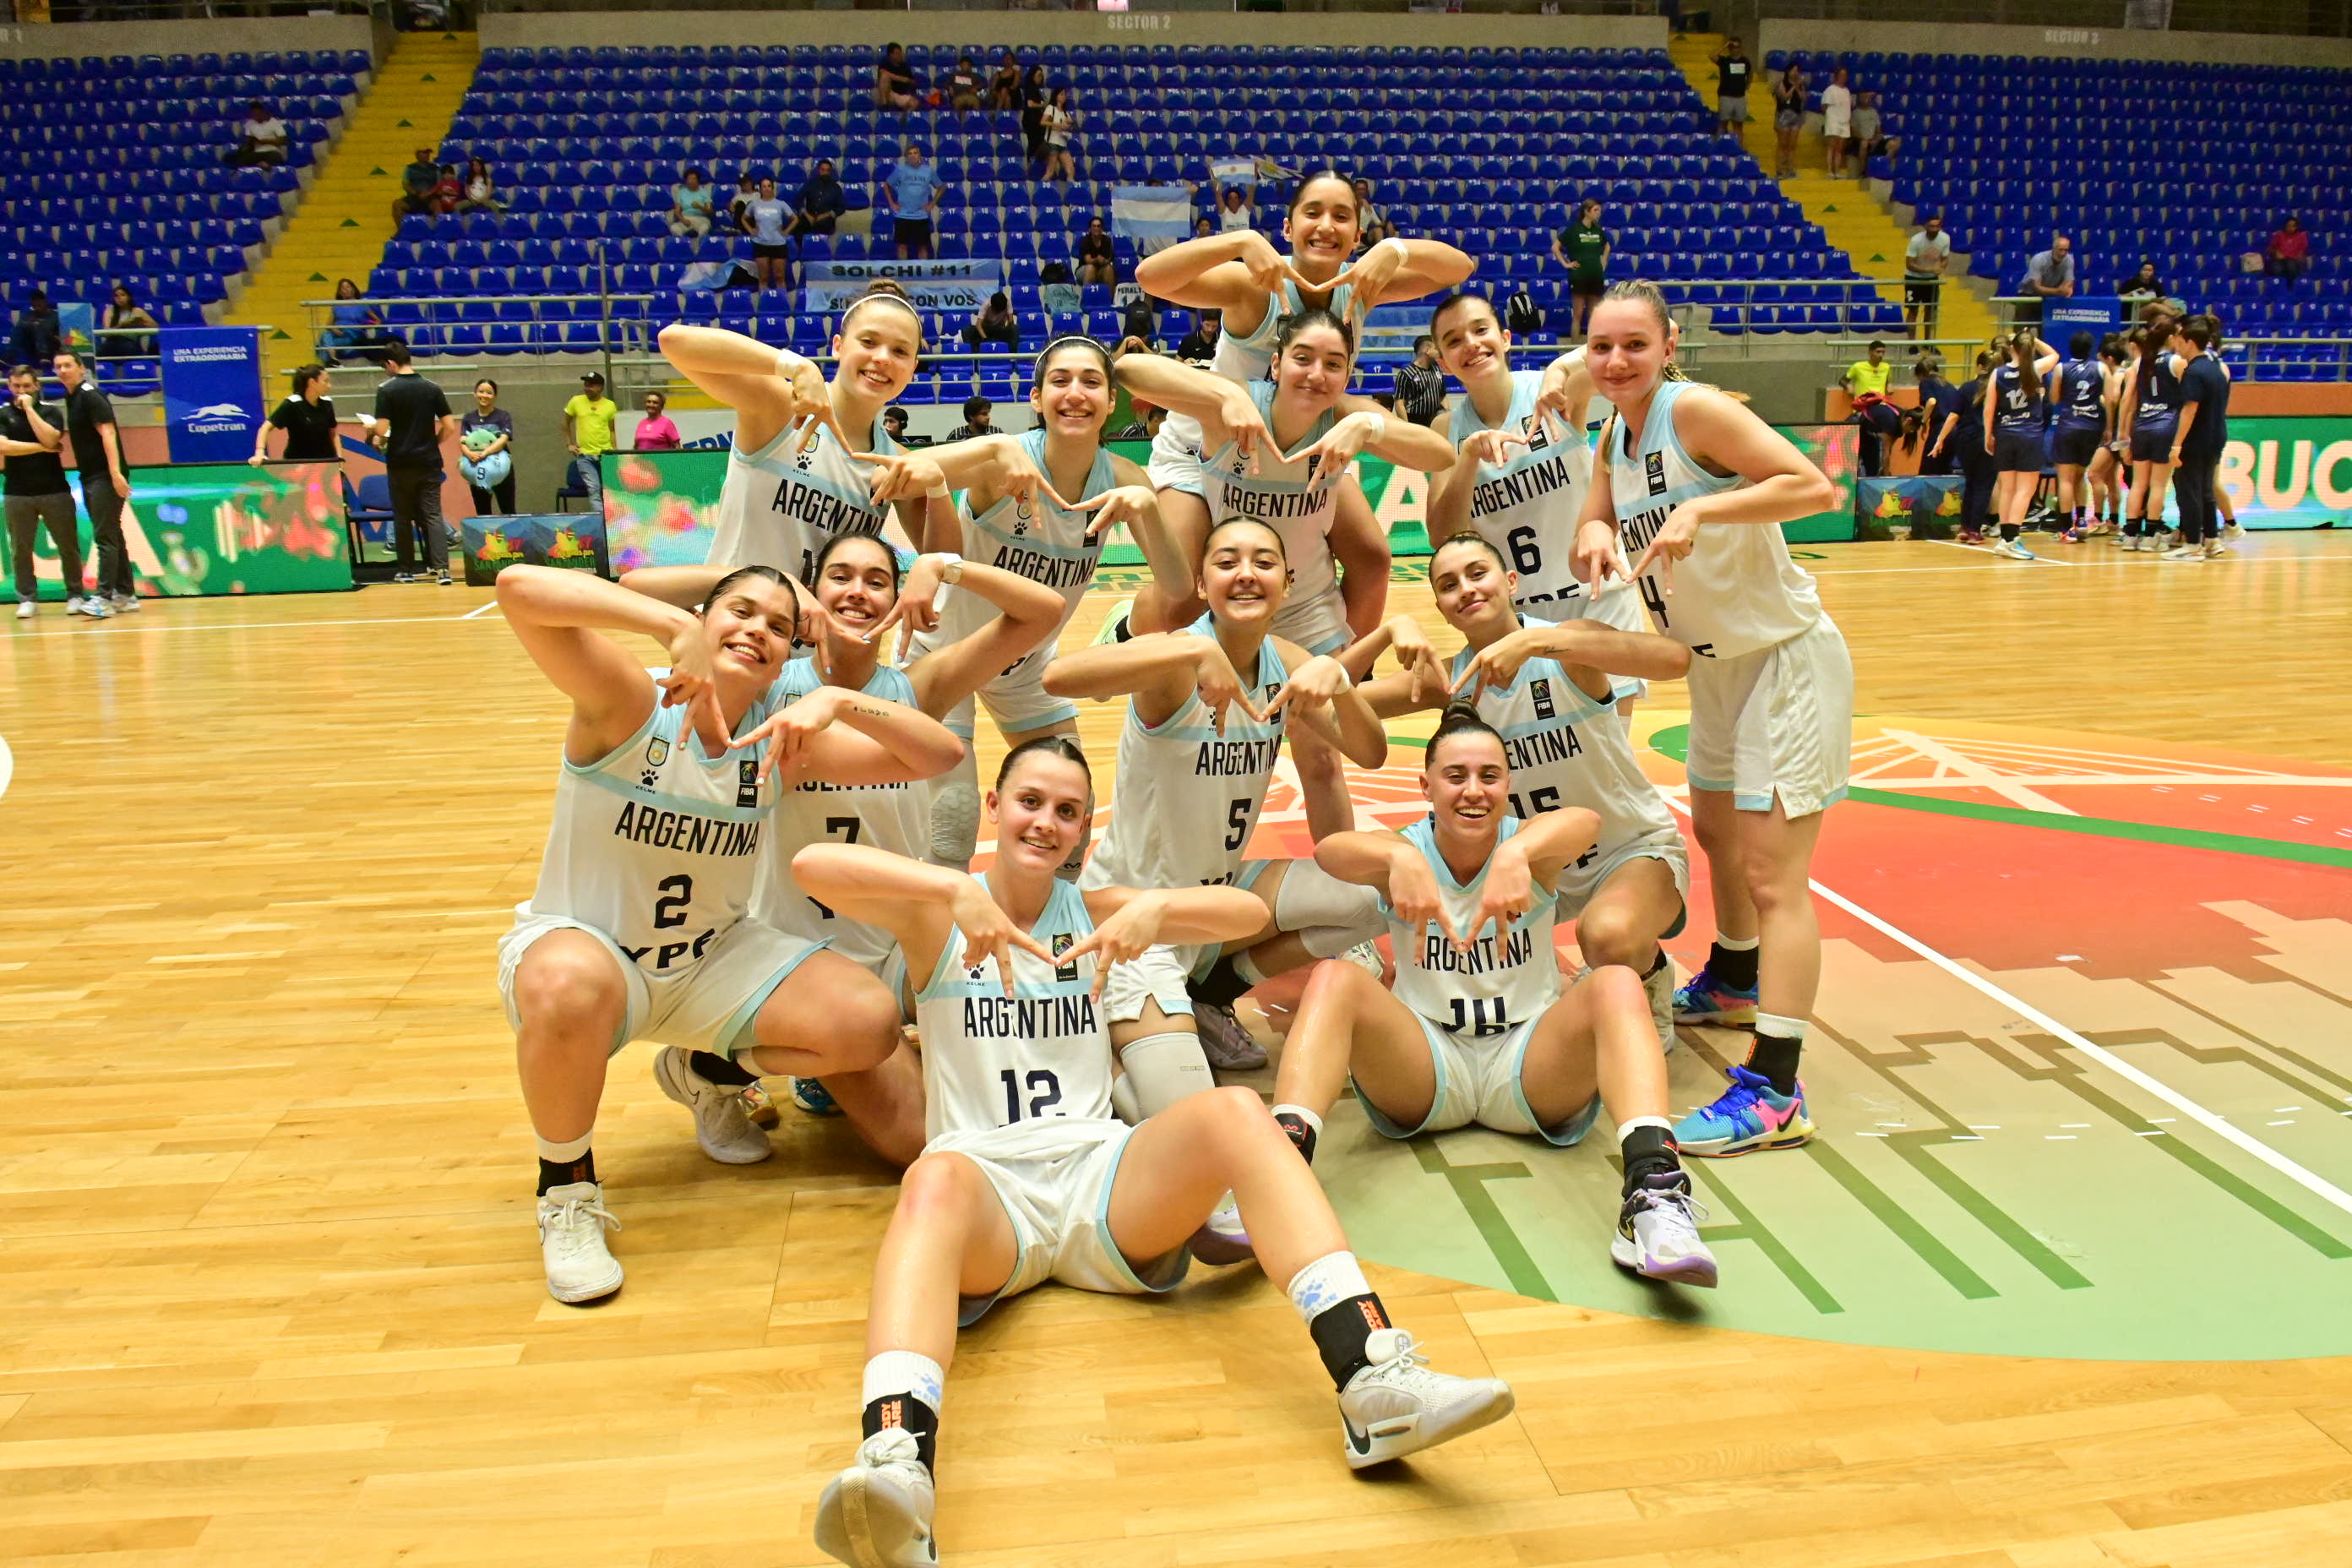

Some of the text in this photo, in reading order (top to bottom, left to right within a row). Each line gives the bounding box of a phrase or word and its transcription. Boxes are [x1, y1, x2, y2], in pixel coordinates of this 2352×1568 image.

[1108, 15, 1171, 29] SECTOR 2
[831, 265, 972, 277] SOLCHI #11
[910, 295, 974, 307] CON VOS
[193, 346, 247, 355] EXPERIENCIA
[2006, 389, 2028, 410] 12
[2076, 380, 2091, 401] 2
[188, 423, 247, 434] Copetran
[476, 466, 487, 481] 9
[1471, 456, 1571, 519] RGENTINA
[1223, 482, 1327, 518] ARGENTINA
[1507, 525, 1542, 575] 6
[1638, 574, 1669, 629] 4
[1195, 734, 1282, 776] ARGENTIN
[1504, 725, 1582, 770] ENTINA
[614, 801, 760, 857] ARGENTINA
[1225, 798, 1252, 851] 5
[654, 874, 693, 928] 2
[999, 1069, 1066, 1127] 12
